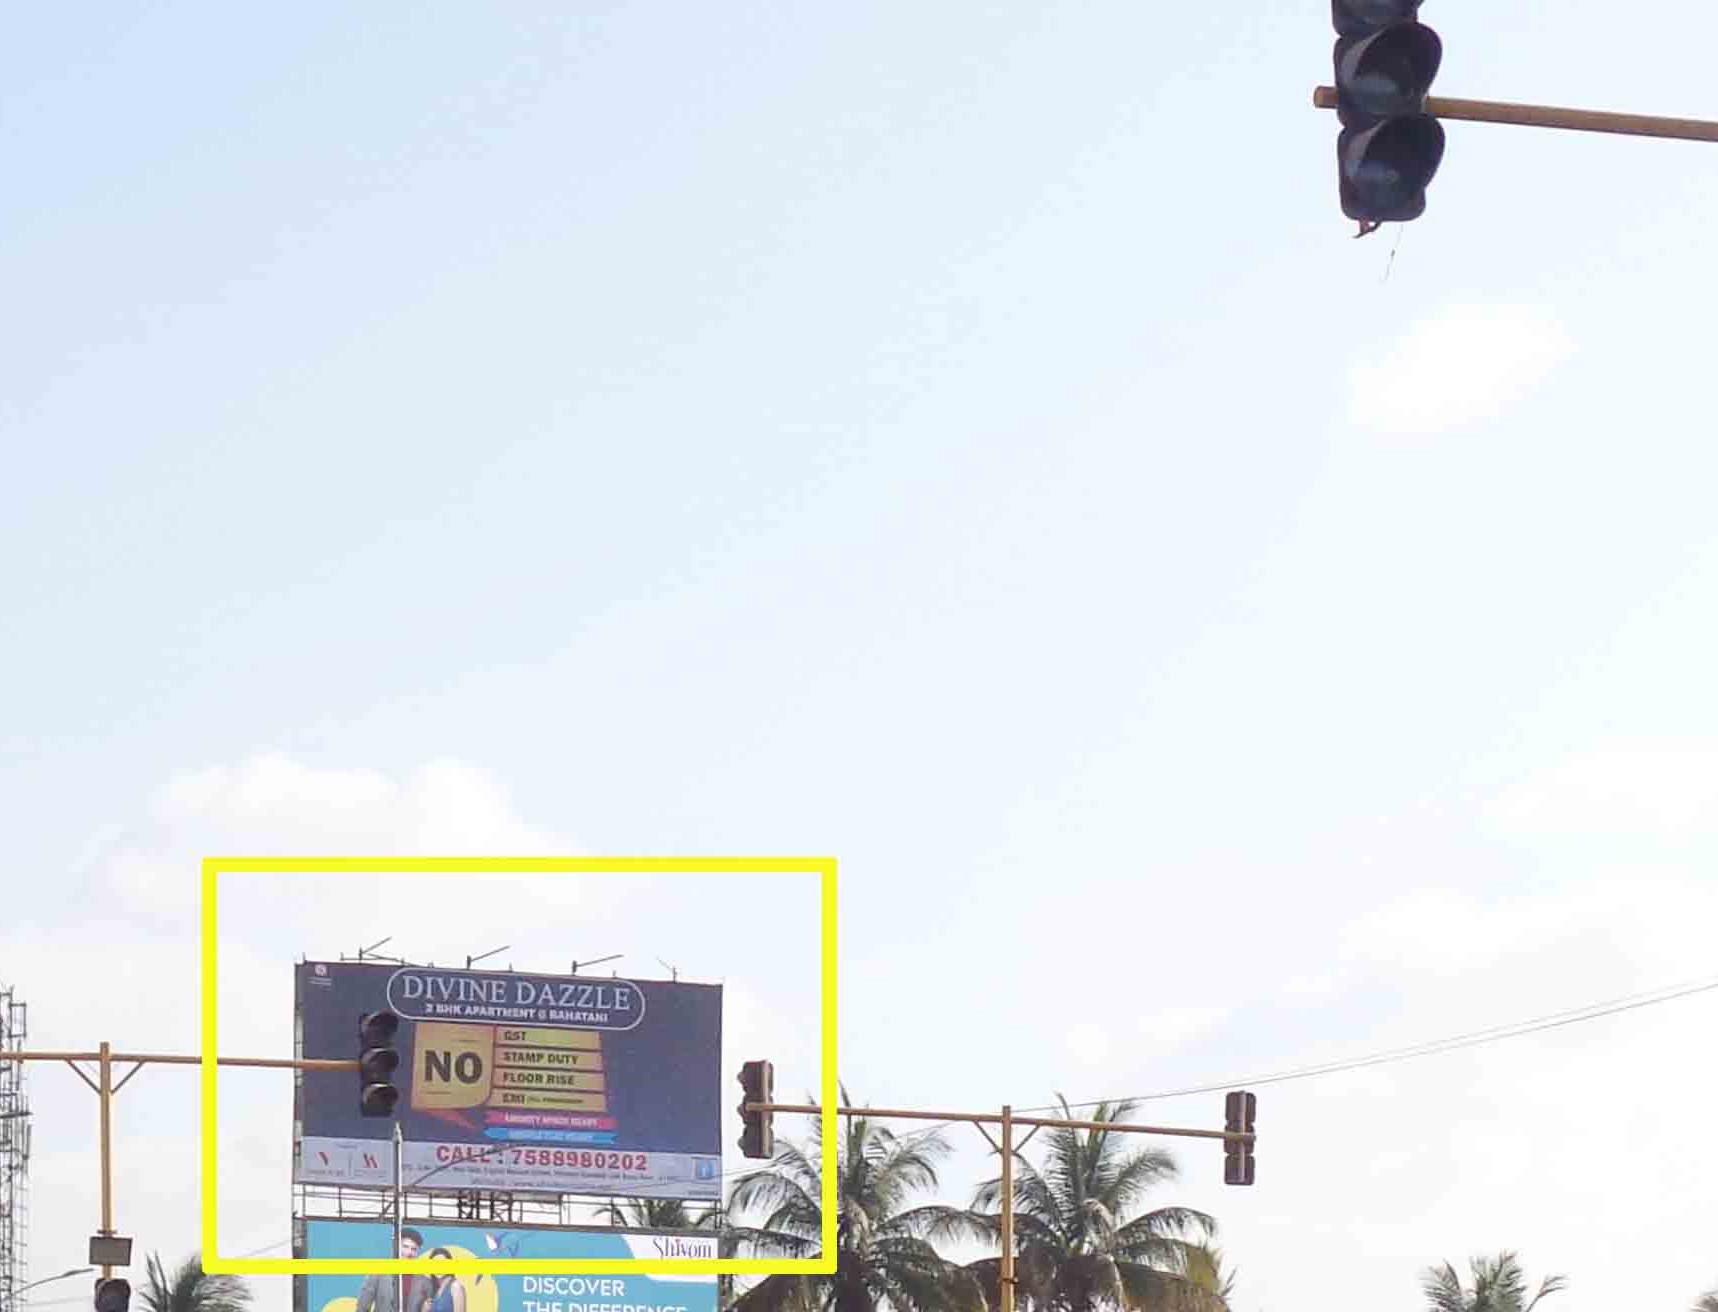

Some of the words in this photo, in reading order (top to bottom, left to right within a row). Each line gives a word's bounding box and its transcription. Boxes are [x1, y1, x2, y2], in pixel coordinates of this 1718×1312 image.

[402, 975, 507, 1003] DIVINE
[515, 982, 630, 1011] DAZZLE
[436, 1004, 464, 1014] BHK
[466, 1005, 534, 1019] APARTMENT
[504, 1031, 526, 1041] GST
[424, 1050, 483, 1084] NO
[503, 1051, 543, 1063] STAMP
[547, 1053, 579, 1065] DUTY
[502, 1071, 544, 1084] FLOOR
[546, 1073, 576, 1086] RISE
[436, 1146, 491, 1164] CALL
[510, 1150, 649, 1171] 7588980202
[652, 1237, 712, 1260] Shivom
[522, 1276, 626, 1296] DISCOVER
